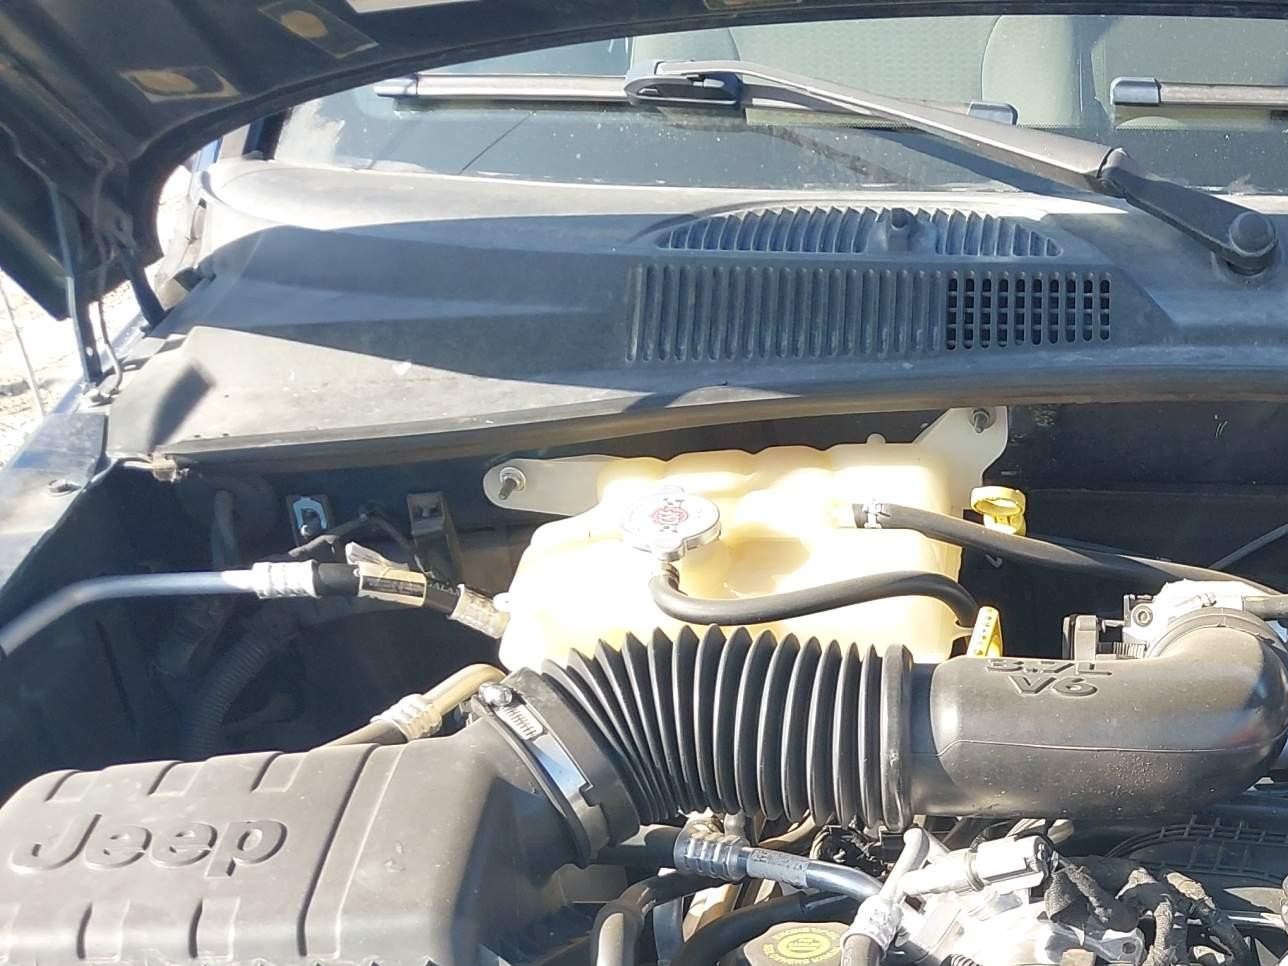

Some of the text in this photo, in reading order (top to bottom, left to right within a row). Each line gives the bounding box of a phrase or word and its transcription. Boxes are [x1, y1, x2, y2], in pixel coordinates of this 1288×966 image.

[985, 658, 1113, 676] 3.7L
[1008, 675, 1098, 698] V6
[10, 813, 288, 879] Jeep
